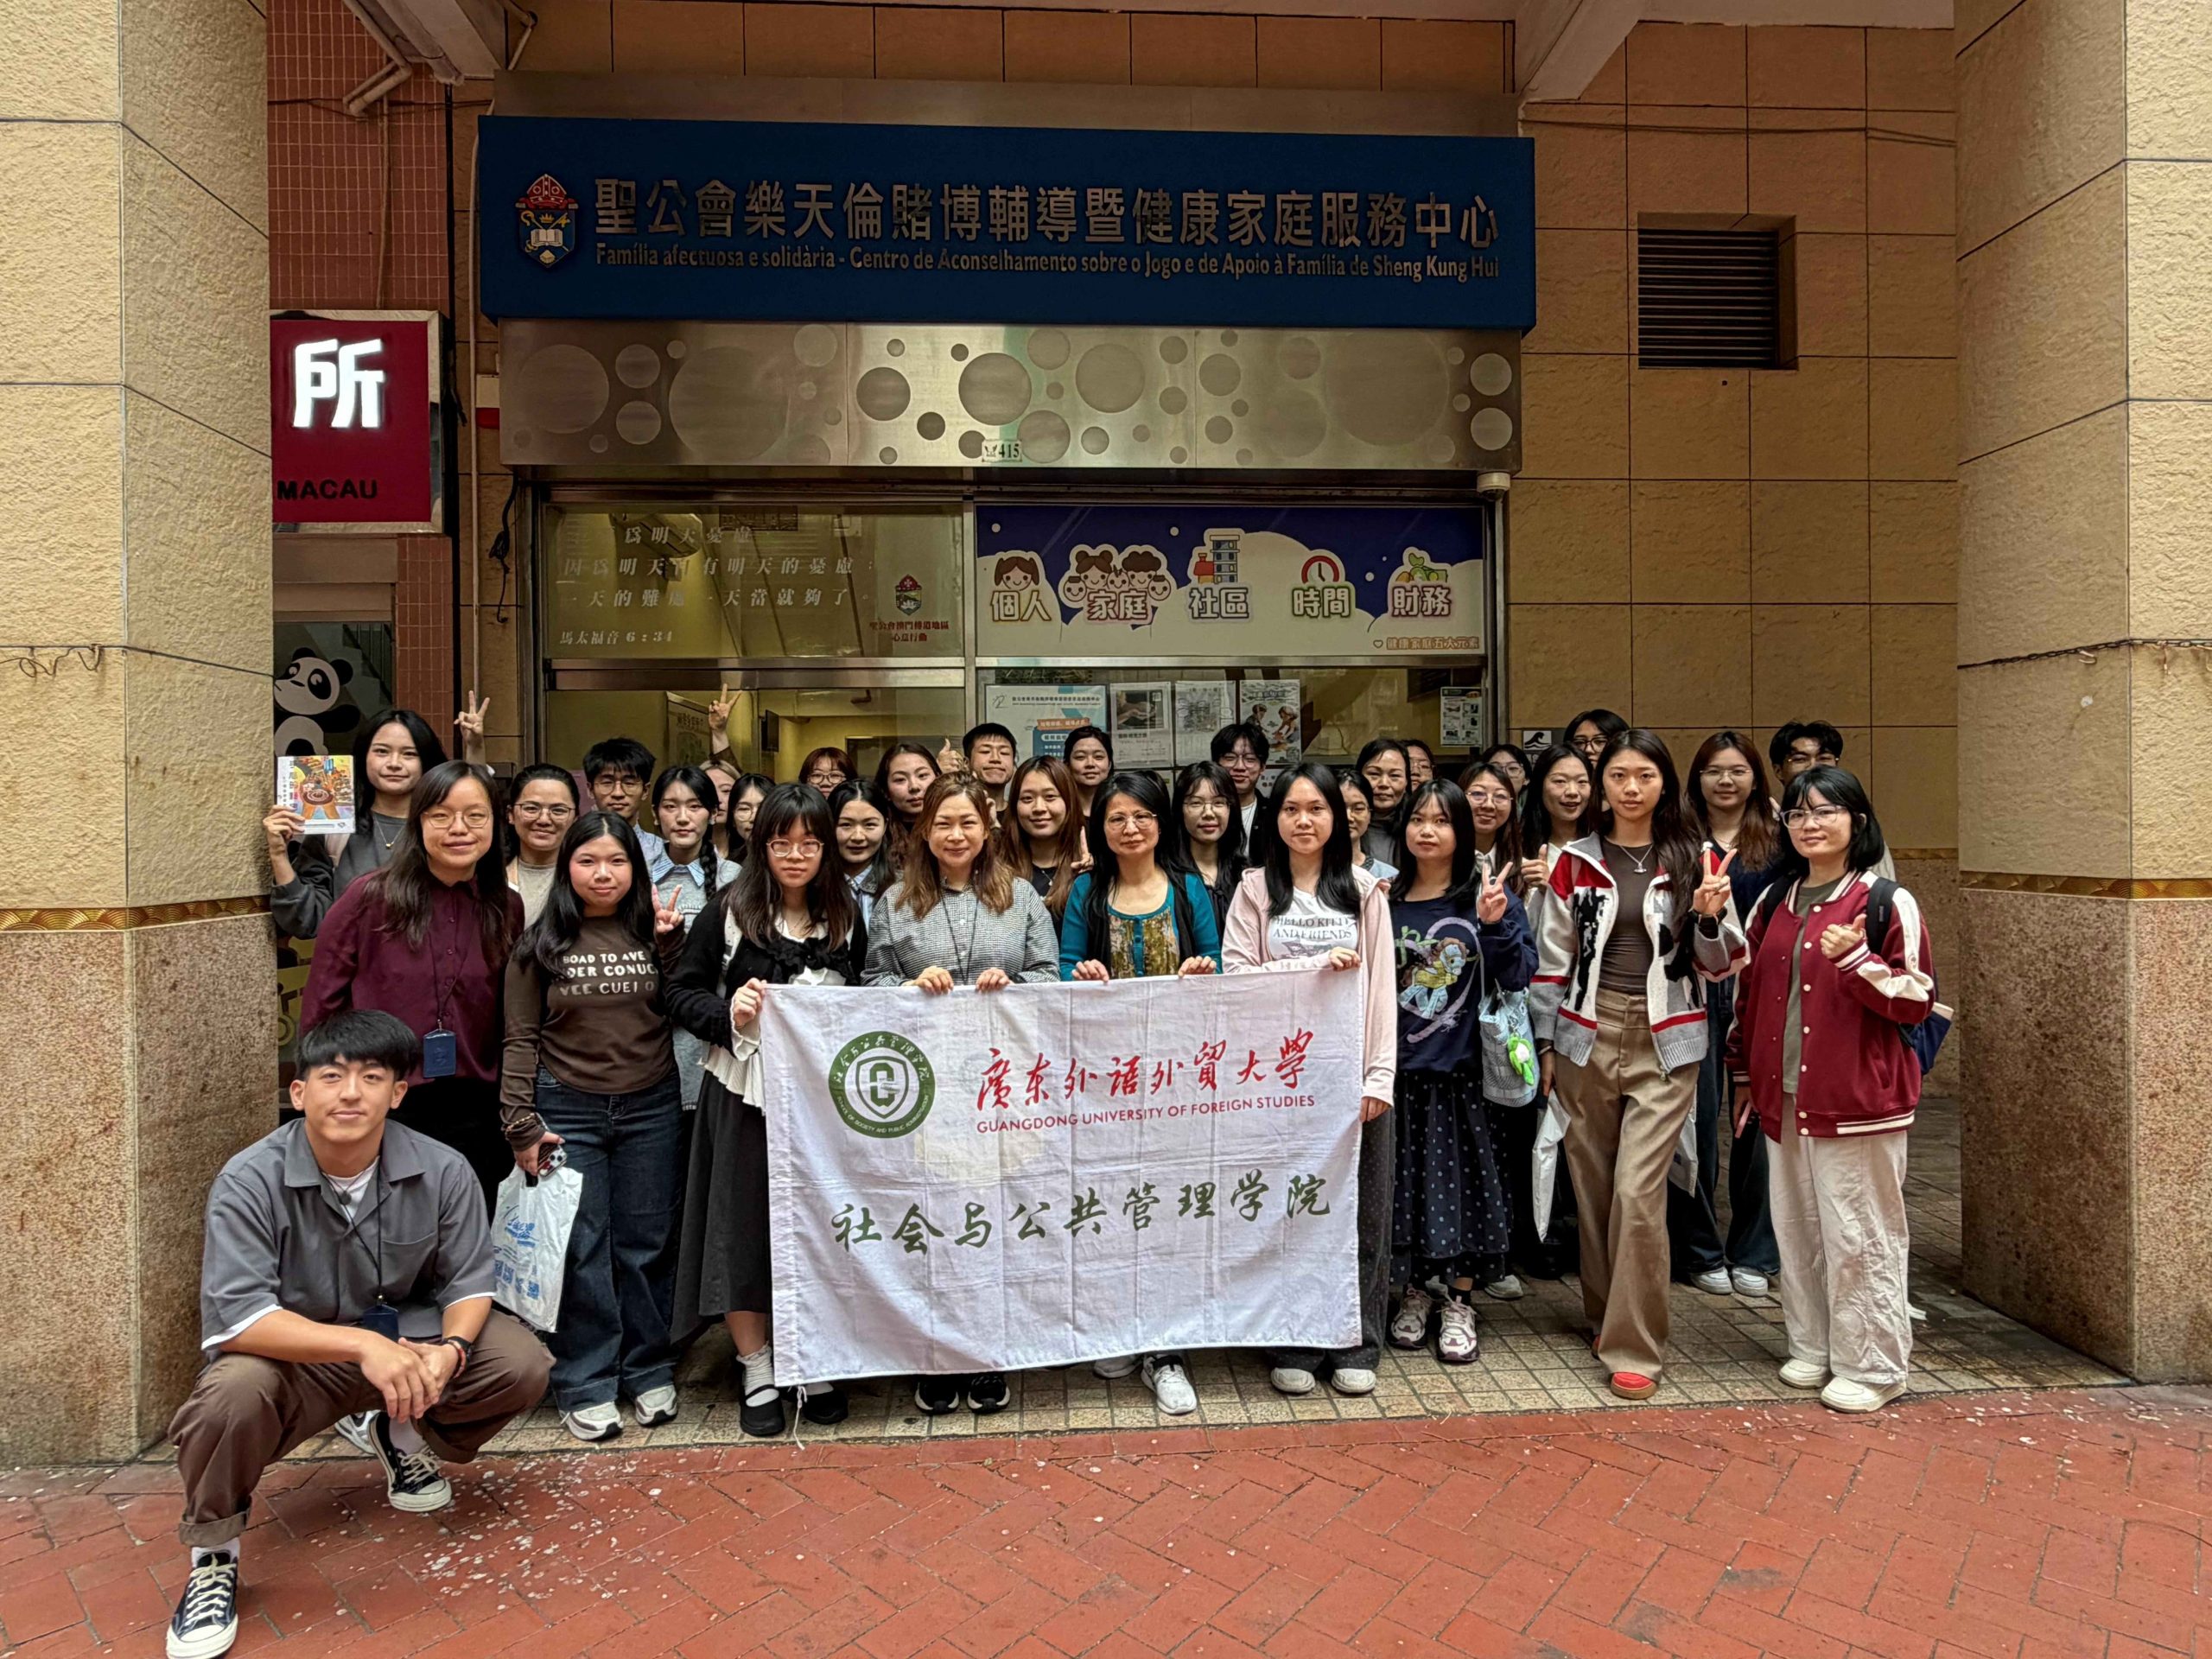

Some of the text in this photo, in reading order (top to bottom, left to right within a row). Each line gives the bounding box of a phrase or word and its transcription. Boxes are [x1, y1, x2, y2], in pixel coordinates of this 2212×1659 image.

[595, 179, 1499, 248] 聖公會樂天倫賭博輔導暨健康家庭服務中心
[596, 242, 658, 265] Família
[663, 244, 745, 266] afectuosa
[750, 251, 759, 267] e
[850, 247, 908, 269] Centro
[913, 248, 934, 270] de
[938, 249, 1077, 272] Aconselhamento
[1081, 250, 1127, 272] sobre
[1131, 257, 1141, 273] o
[1145, 251, 1181, 279] Jogo
[1185, 257, 1194, 273] e
[1198, 251, 1218, 274] de
[1222, 252, 1270, 281] Apoio
[1274, 253, 1283, 275] à
[1288, 253, 1346, 276] Família
[1350, 255, 1370, 276] de
[1373, 255, 1422, 283] Sheng
[1427, 255, 1468, 283] Kung
[1471, 257, 1500, 277] Hui
[292, 337, 386, 429] 所
[276, 479, 378, 499] MACAU
[992, 590, 1052, 621] 個人
[1087, 588, 1149, 620] 家庭
[1189, 587, 1250, 620] 社區
[1292, 585, 1351, 617] 時間
[1392, 585, 1452, 617] 財務
[600, 953, 617, 963] TO
[976, 1095, 1315, 1135] GUANGDONG UNIVERSITY OF FOREIGN STUDIES
[830, 1169, 1331, 1255] 社会与公共管理学院
